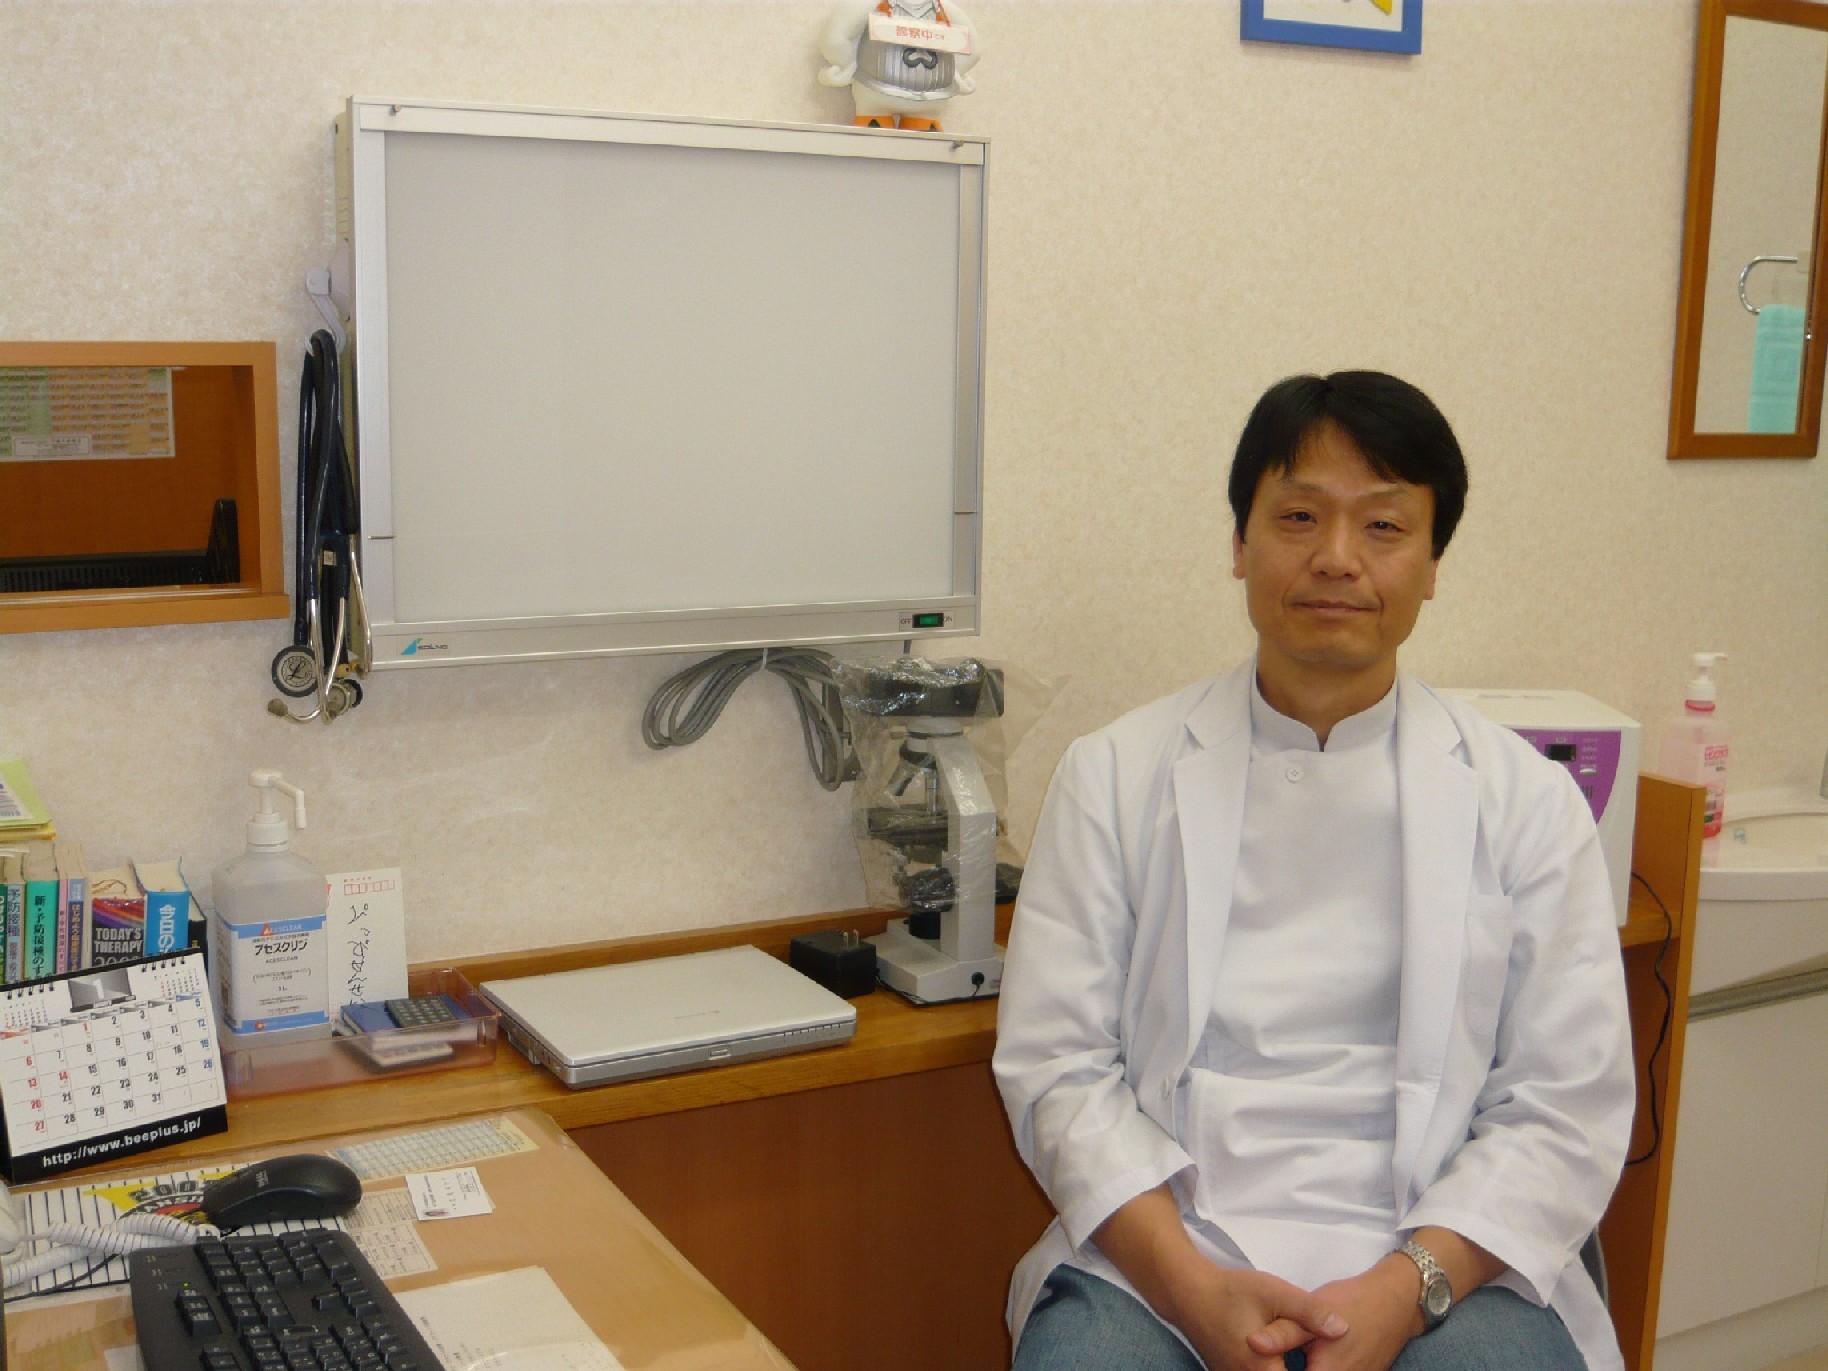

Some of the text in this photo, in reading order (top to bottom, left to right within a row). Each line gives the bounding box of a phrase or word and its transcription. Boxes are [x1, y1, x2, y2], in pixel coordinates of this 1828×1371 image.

[32, 896, 46, 976] 新・予防接種のす
[94, 940, 142, 953] THERAPY
[96, 928, 140, 940] TODAY'S
[255, 939, 308, 956] アセスクリン
[83, 998, 200, 1031] 1 2 3 4 5
[26, 1019, 206, 1065] 6 7 8 9 10 11 12
[28, 1039, 209, 1088] 13 14 15 16 17 18 19
[31, 1060, 212, 1109] 20 21 22 23 24 25 26
[35, 1093, 161, 1131] 27 28 29 30 31
[42, 1117, 201, 1167] http://www.beeplus.jp/
